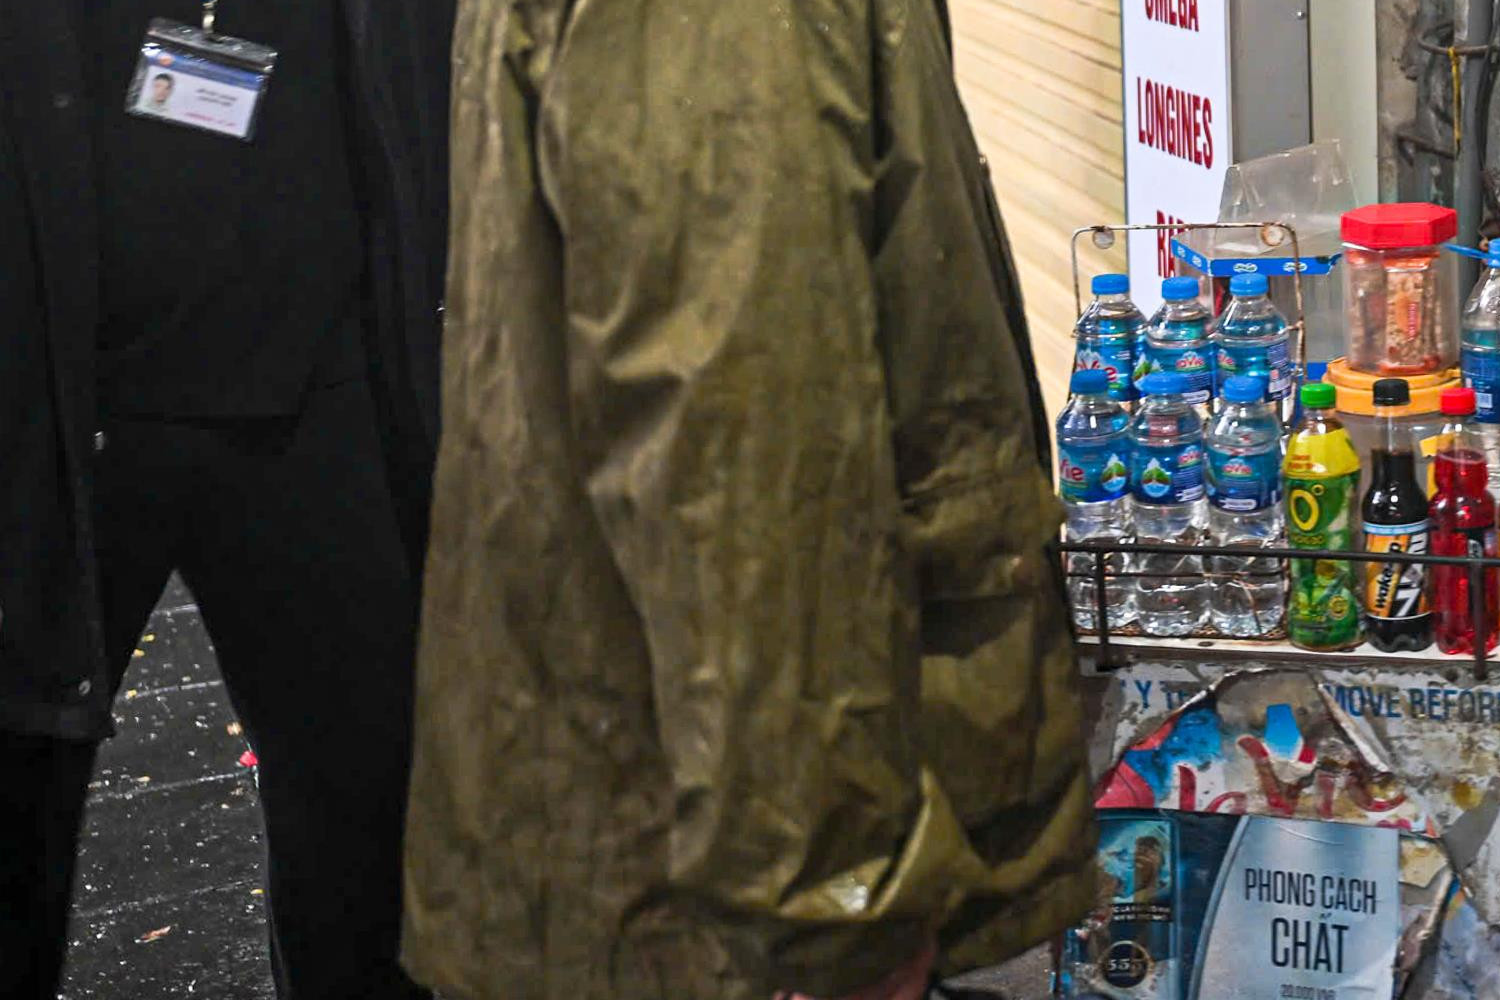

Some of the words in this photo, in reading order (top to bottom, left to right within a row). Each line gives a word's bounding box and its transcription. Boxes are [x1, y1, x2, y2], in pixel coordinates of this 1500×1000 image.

[1137, 76, 1214, 170] LONGINES
[1245, 867, 1316, 908] PHONG
[1271, 912, 1350, 974] CHẤT
